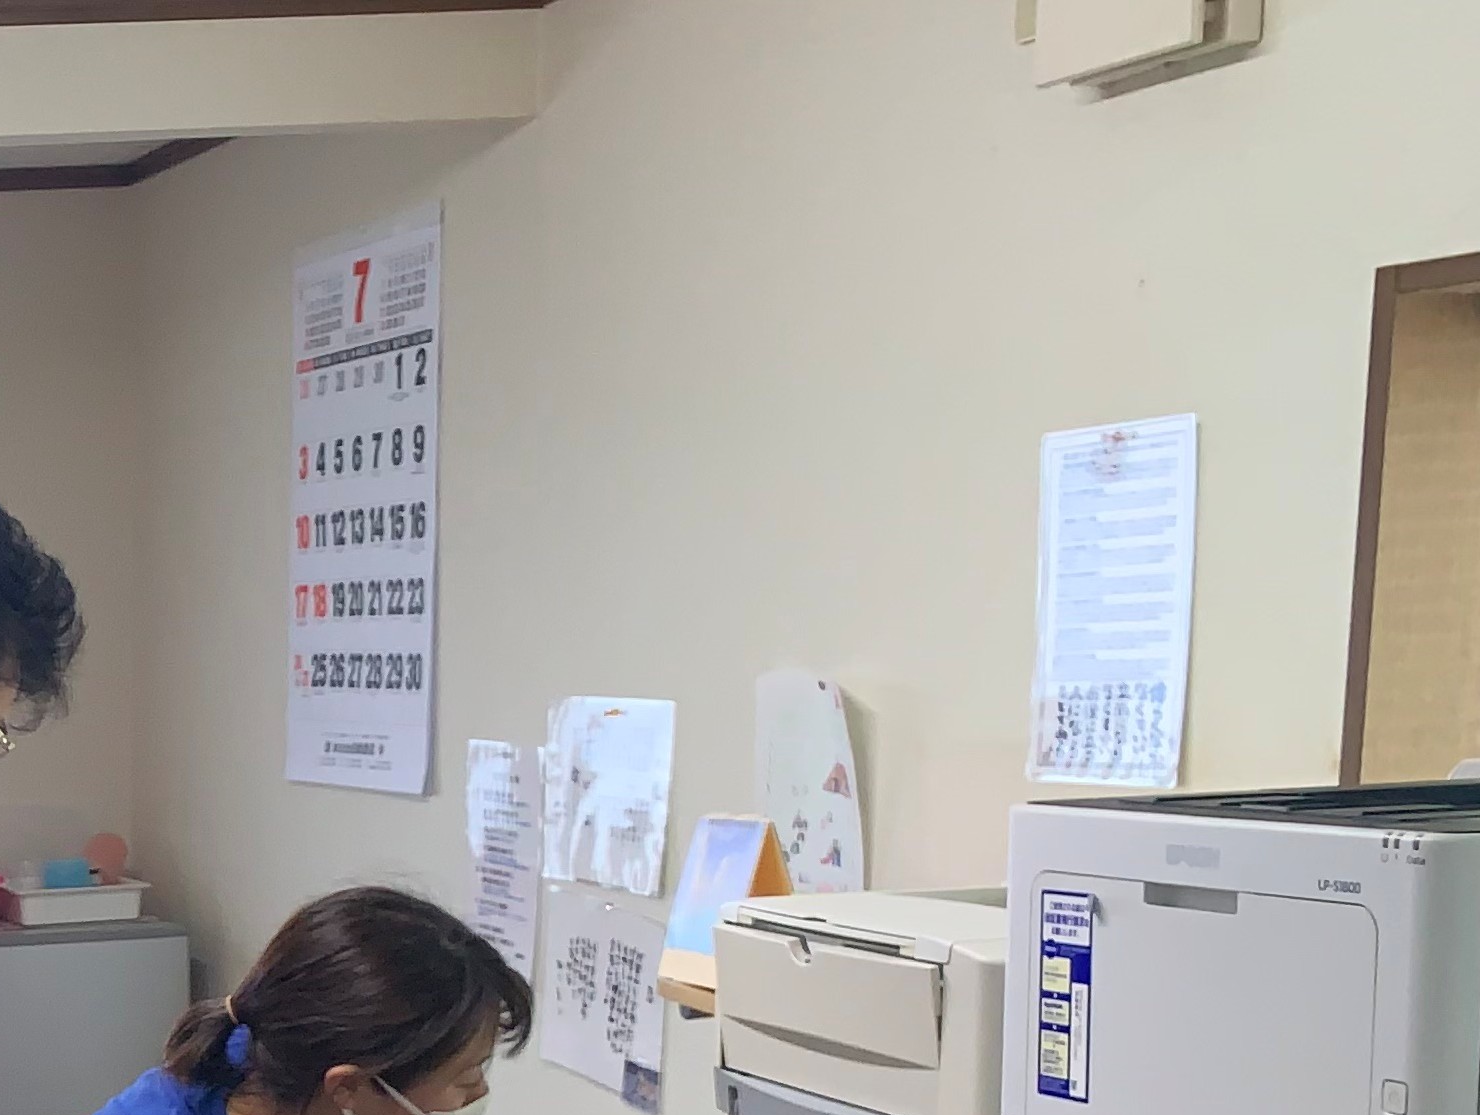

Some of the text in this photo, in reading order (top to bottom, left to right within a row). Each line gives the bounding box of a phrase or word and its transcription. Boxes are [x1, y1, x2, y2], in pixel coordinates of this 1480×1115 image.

[353, 258, 371, 324] 7
[394, 352, 404, 390] 1
[414, 347, 427, 387] 2
[298, 423, 425, 480] 3 4 5 6 7 8 9
[295, 501, 426, 549] 10 11 12 13 14 15 16
[295, 577, 425, 618] 17 18 19 20 21 22 23
[311, 653, 327, 688] 25
[329, 653, 346, 688] 26
[347, 653, 364, 689] 27
[365, 653, 383, 690] 28
[385, 653, 403, 690] 29
[405, 652, 423, 691] 30
